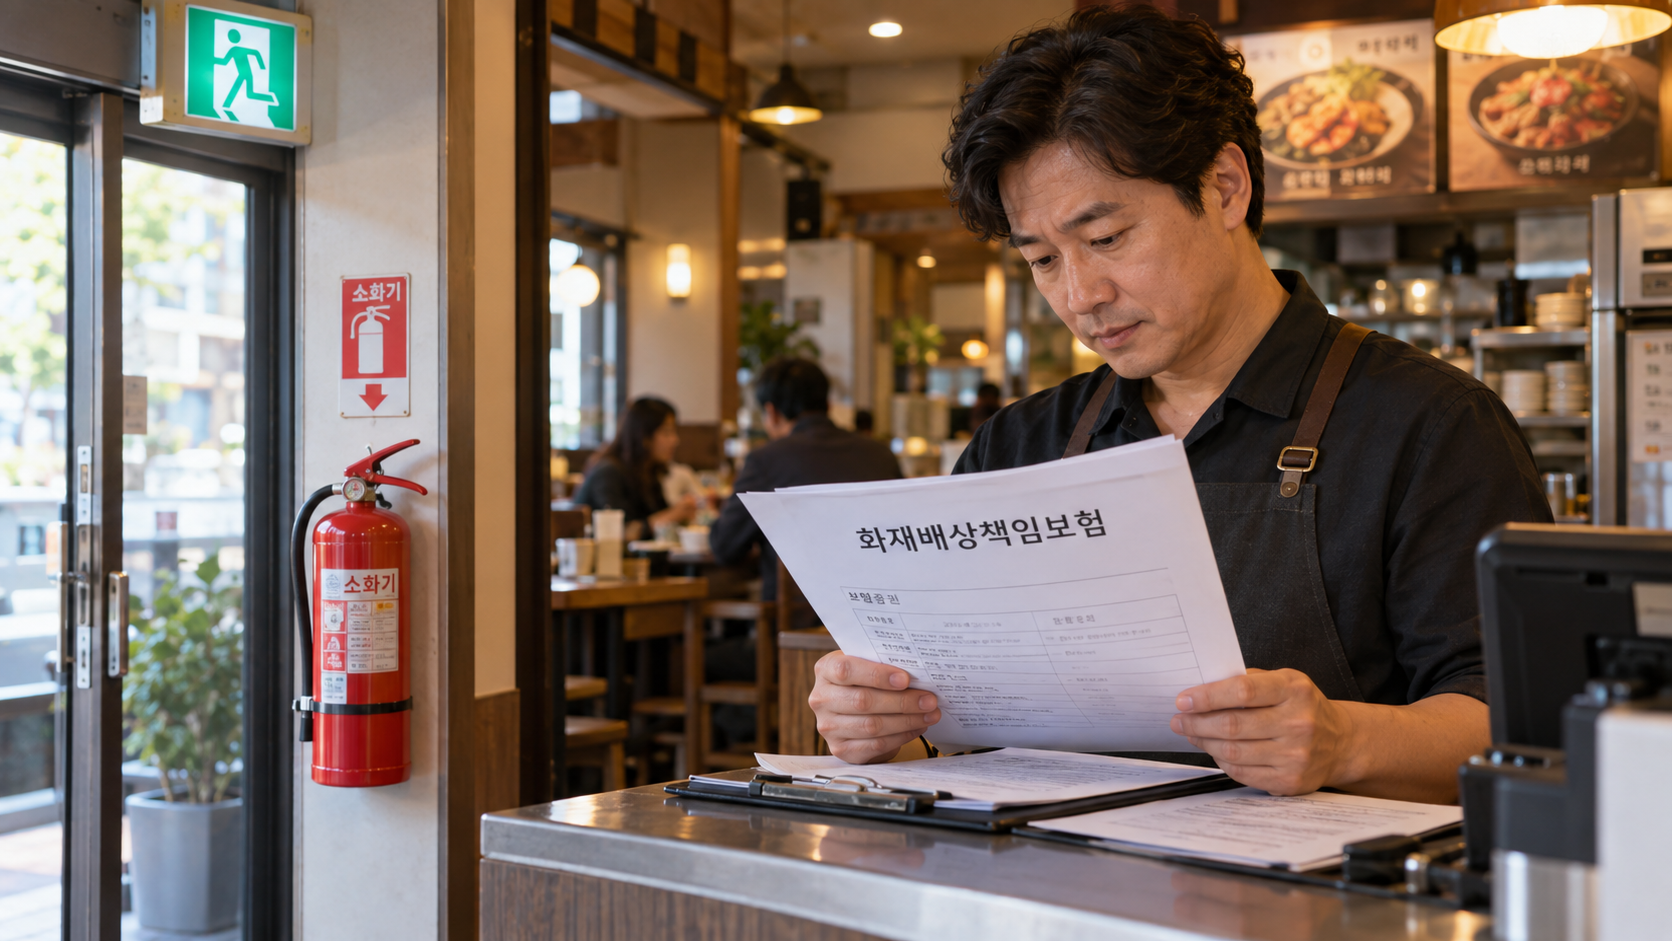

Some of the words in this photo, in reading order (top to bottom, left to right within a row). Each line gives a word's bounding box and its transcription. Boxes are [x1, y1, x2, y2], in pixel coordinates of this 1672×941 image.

[352, 281, 401, 303] 소화기
[856, 509, 1107, 553] 화재배상책임보험
[344, 573, 395, 595] 소화기
